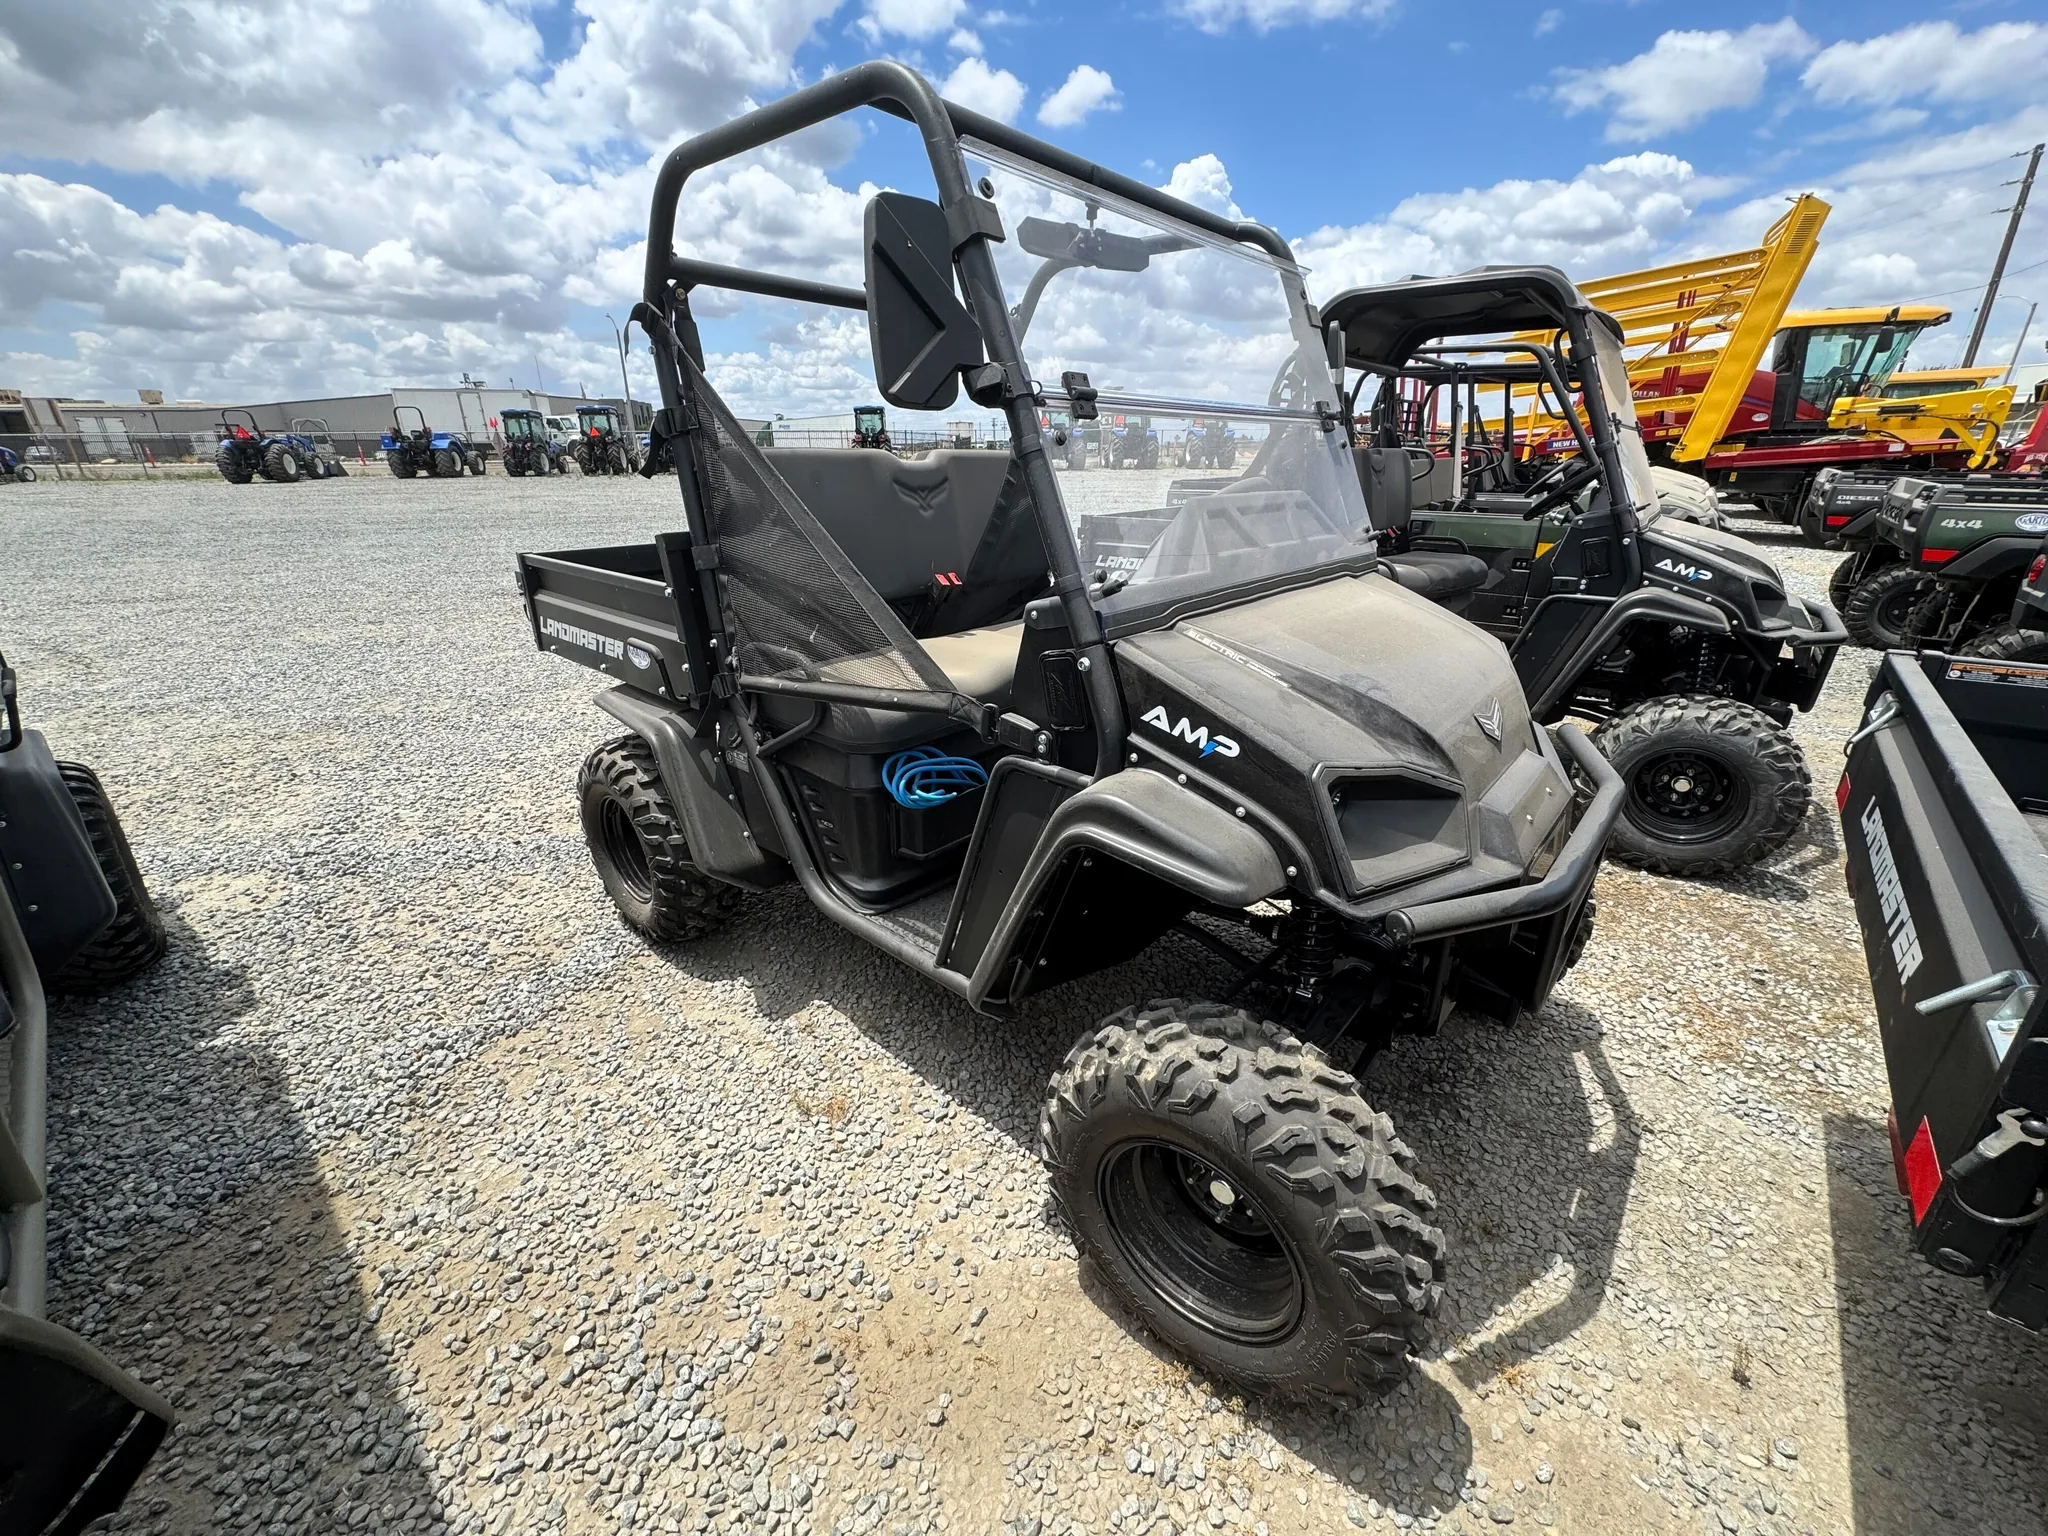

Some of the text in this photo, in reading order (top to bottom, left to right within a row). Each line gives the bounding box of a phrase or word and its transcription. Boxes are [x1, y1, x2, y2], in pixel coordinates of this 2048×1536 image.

[1633, 390, 1660, 398] OLLAN
[1552, 440, 1570, 448] NEW
[1940, 518, 1983, 529] 4x4
[1655, 558, 1713, 582] AMP
[540, 615, 624, 660] LANDMASTER
[1185, 628, 1247, 664] ELECTRIC
[1140, 705, 1240, 758] AMP
[1860, 794, 1924, 985] LANDMASTER
